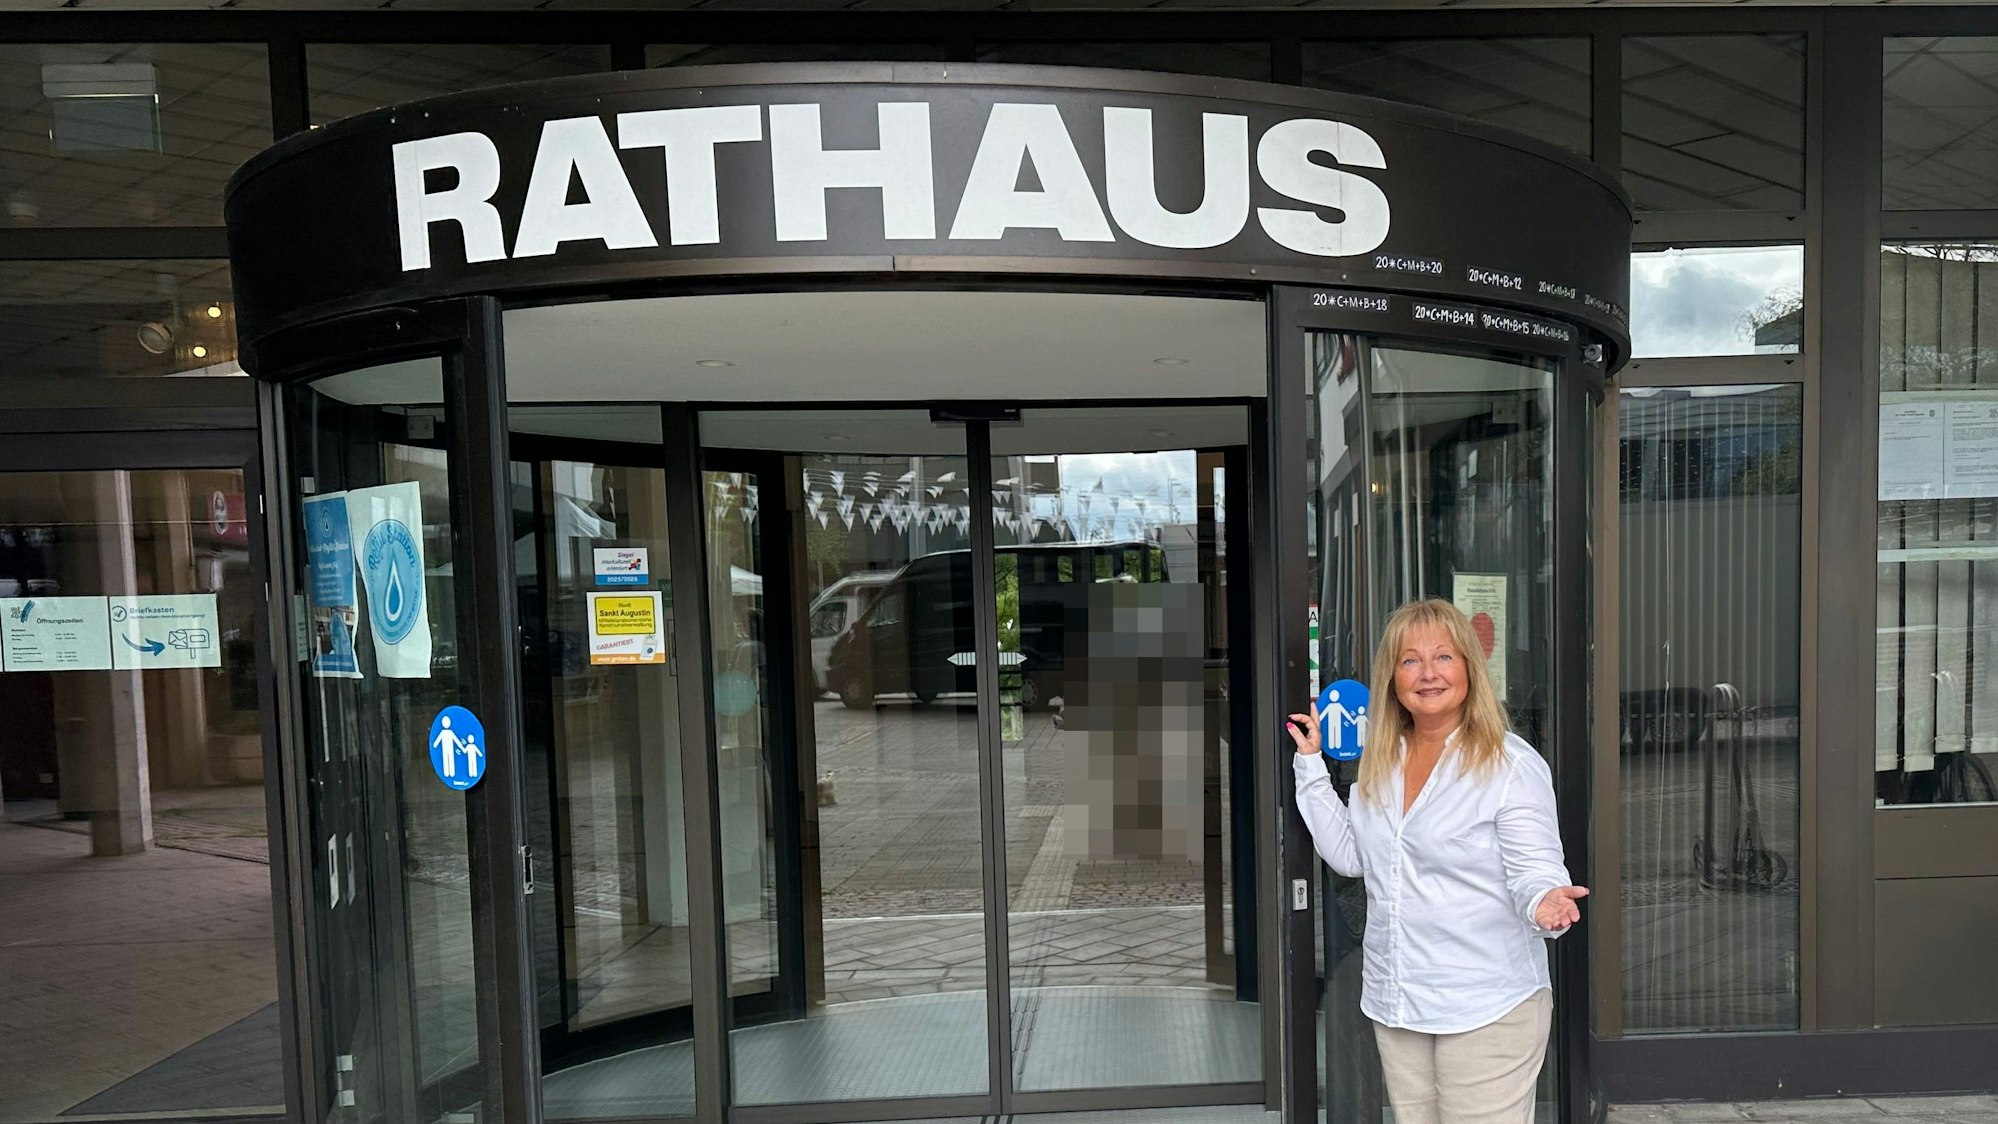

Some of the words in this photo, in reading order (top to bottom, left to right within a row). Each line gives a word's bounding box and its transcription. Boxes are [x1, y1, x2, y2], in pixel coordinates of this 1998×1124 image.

[392, 101, 1390, 272] RATHAUS
[599, 609, 620, 617] Sankt
[620, 609, 651, 618] Augustin
[36, 616, 84, 625] Öffnungszeiten
[596, 639, 634, 651] GARANTIERT
